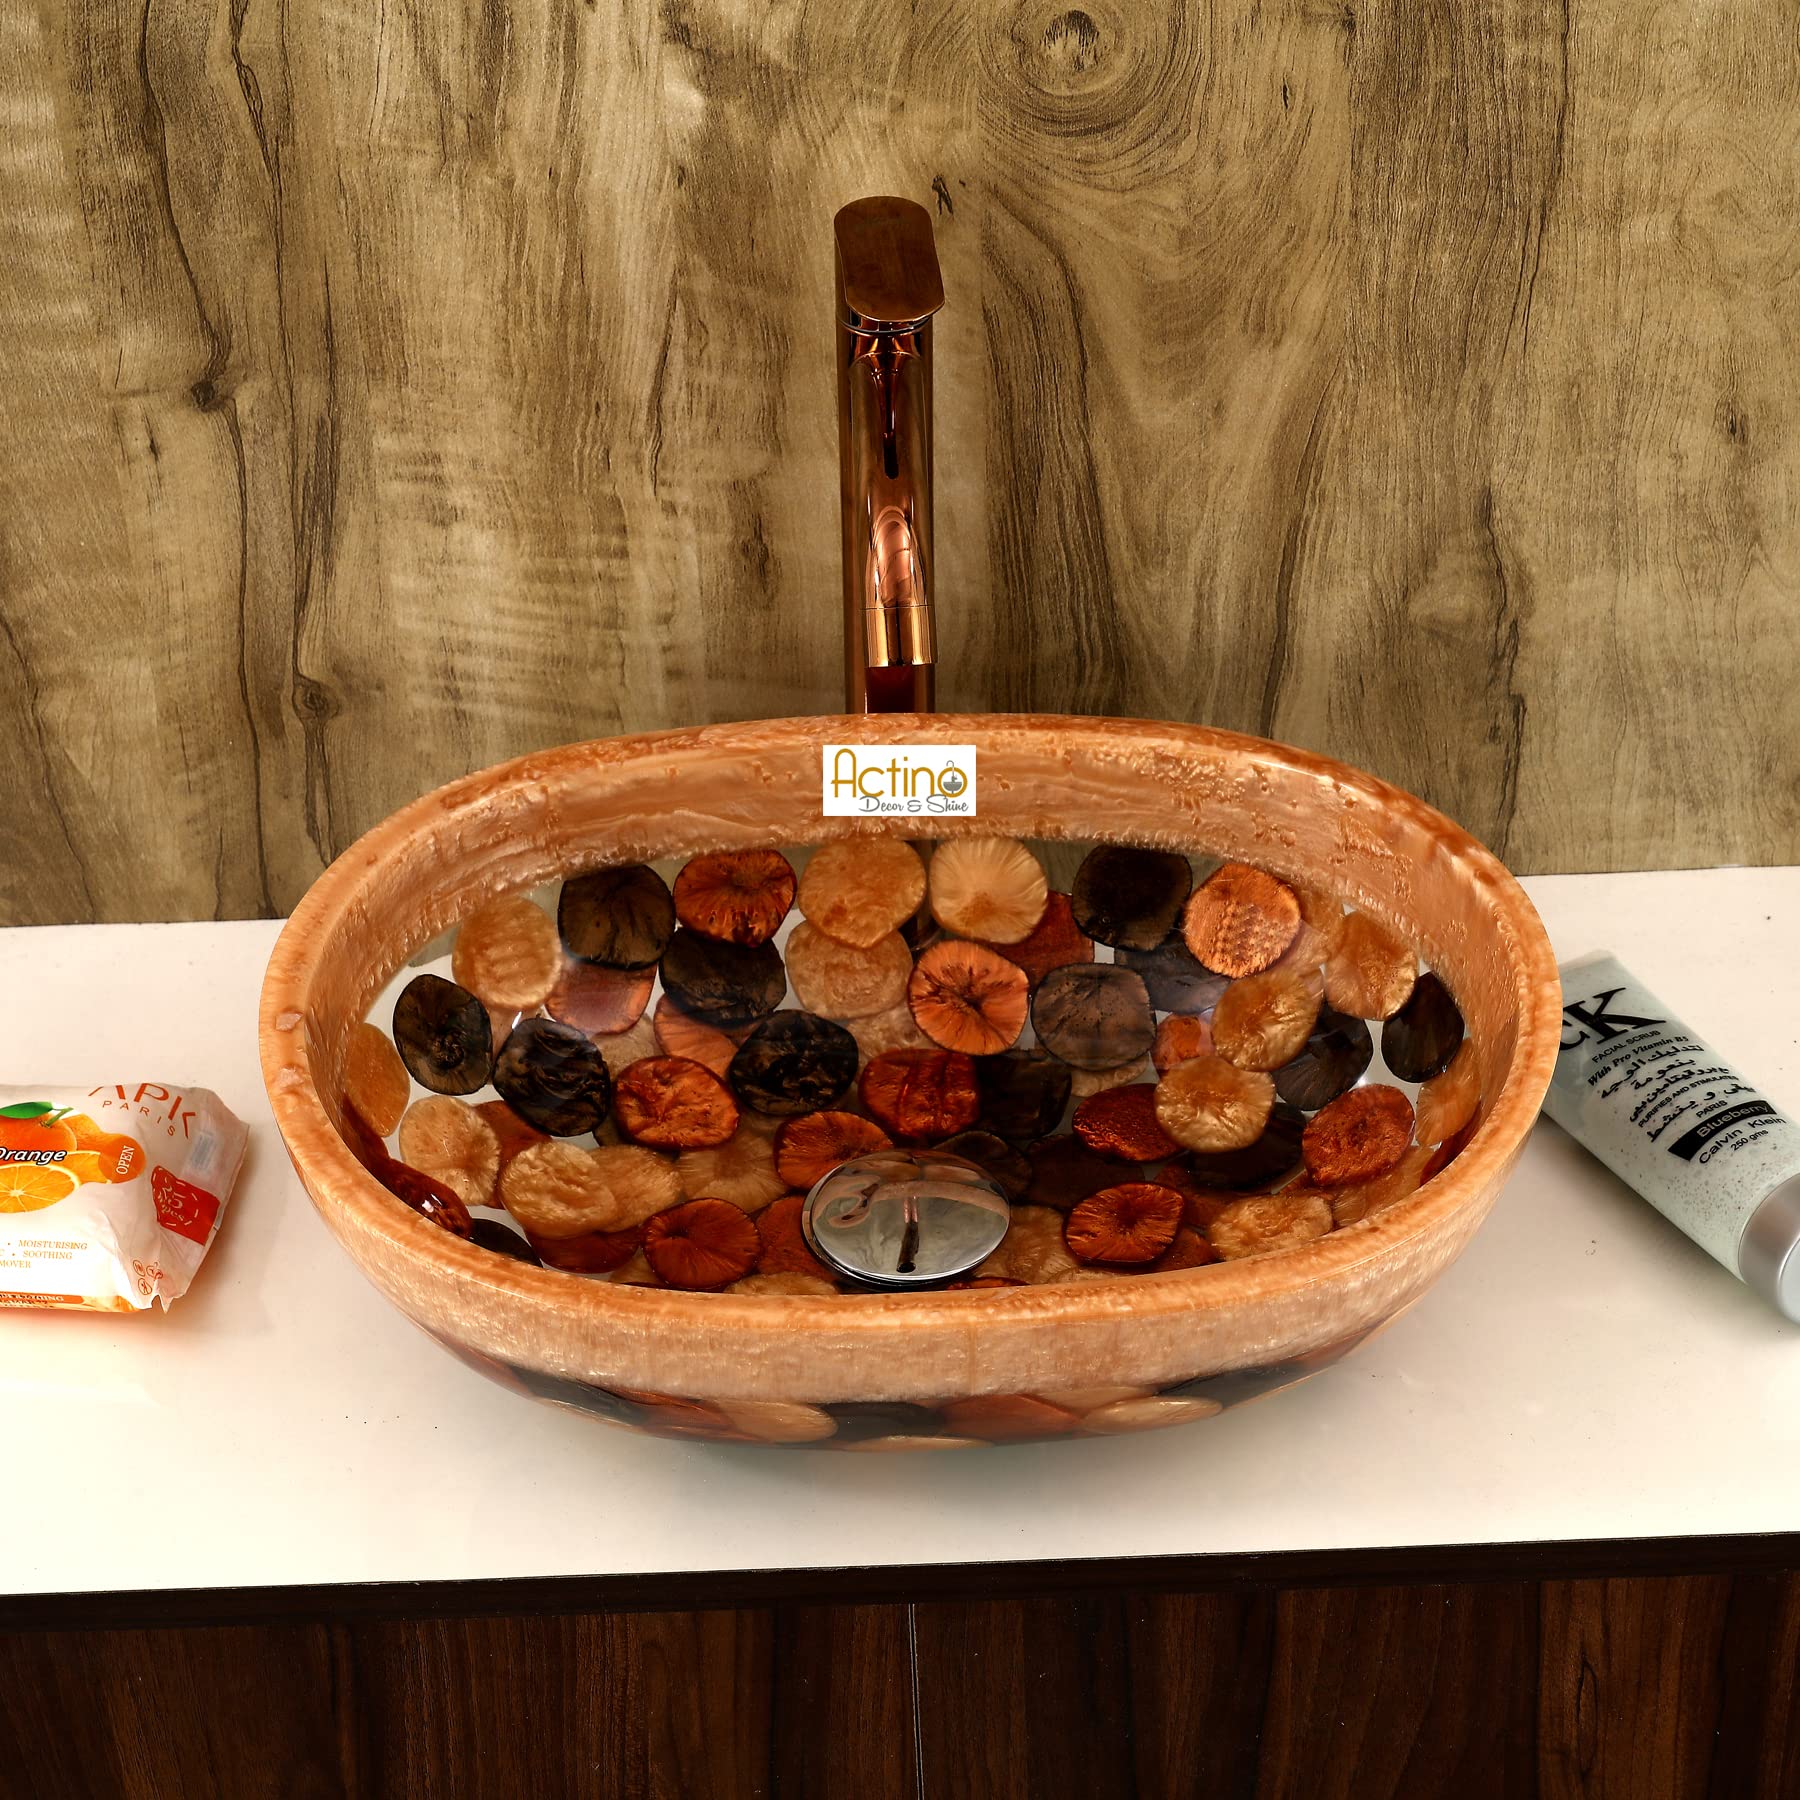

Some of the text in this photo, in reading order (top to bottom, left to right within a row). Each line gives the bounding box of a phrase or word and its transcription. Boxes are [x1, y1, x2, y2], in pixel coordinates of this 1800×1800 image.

[1587, 1064, 1612, 1087] With
[1612, 1054, 1631, 1067] Pro
[1632, 1038, 1673, 1055] Vitamin
[1592, 1030, 1661, 1063] FACIAL SCRUB
[102, 1100, 176, 1137] PARIS
[1638, 1096, 1672, 1128] PURIFIES
[1672, 1086, 1690, 1099] AND
[1695, 1100, 1728, 1118] PARIS
[1696, 1104, 1768, 1138] Blueberry
[1699, 1117, 1787, 1164] Calvin Klein
[1730, 1129, 1769, 1152] 250 gms
[115, 1145, 135, 1175] OPEN
[18, 1239, 88, 1250] MOISTURISING
[22, 1250, 73, 1260] SOOTHING
